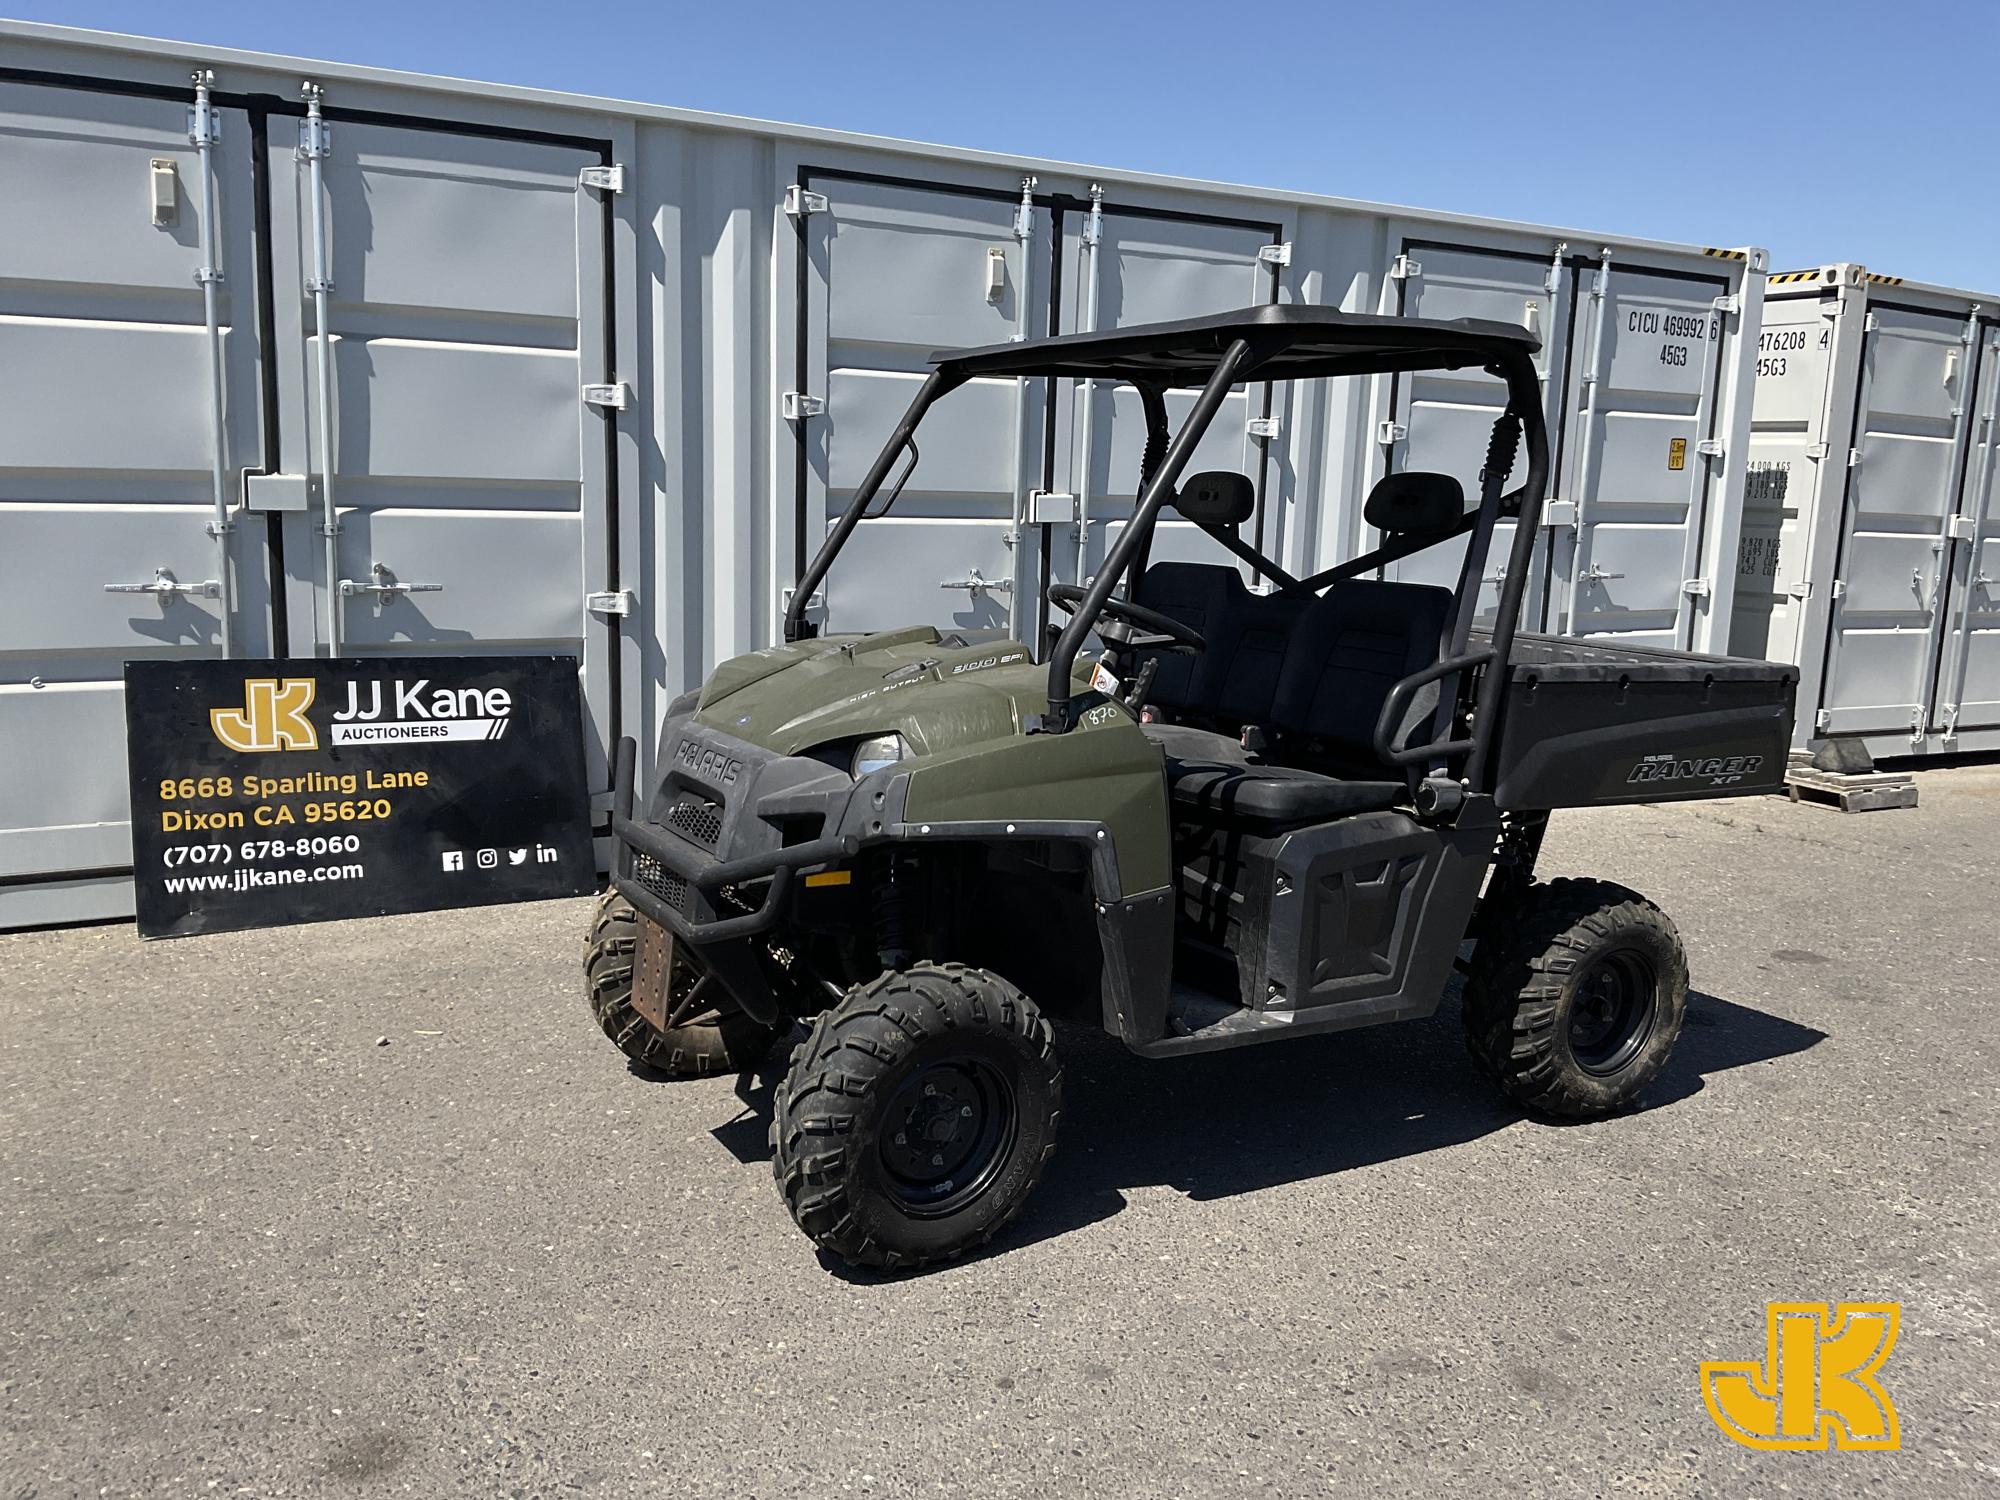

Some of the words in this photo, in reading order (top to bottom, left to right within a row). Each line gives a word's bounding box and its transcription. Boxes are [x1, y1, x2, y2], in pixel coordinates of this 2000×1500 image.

[1629, 311, 1658, 334] CICU
[1663, 315, 1704, 339] 469992
[1710, 320, 1718, 340] 6
[1758, 331, 1806, 352] 476208
[1819, 329, 1829, 349] 4
[1660, 344, 1687, 367] 45G3
[1756, 357, 1787, 377] 45G3
[1001, 653, 1024, 663] EFI
[333, 680, 381, 720] JJ
[395, 680, 511, 718] Kane
[341, 725, 449, 740] AUCTIONEERS
[674, 739, 744, 786] POLARIS
[1626, 756, 1763, 782] RANGER
[160, 776, 233, 800] 8668
[243, 771, 357, 799] Sparling
[366, 769, 429, 789] Lane
[1710, 776, 1741, 784] XP
[162, 809, 244, 832] Dixon
[253, 805, 295, 826] CA
[304, 799, 392, 823] 95620
[163, 843, 232, 868] (707)
[241, 834, 360, 860] 678-8060
[164, 863, 364, 893] www.jjkane.com
